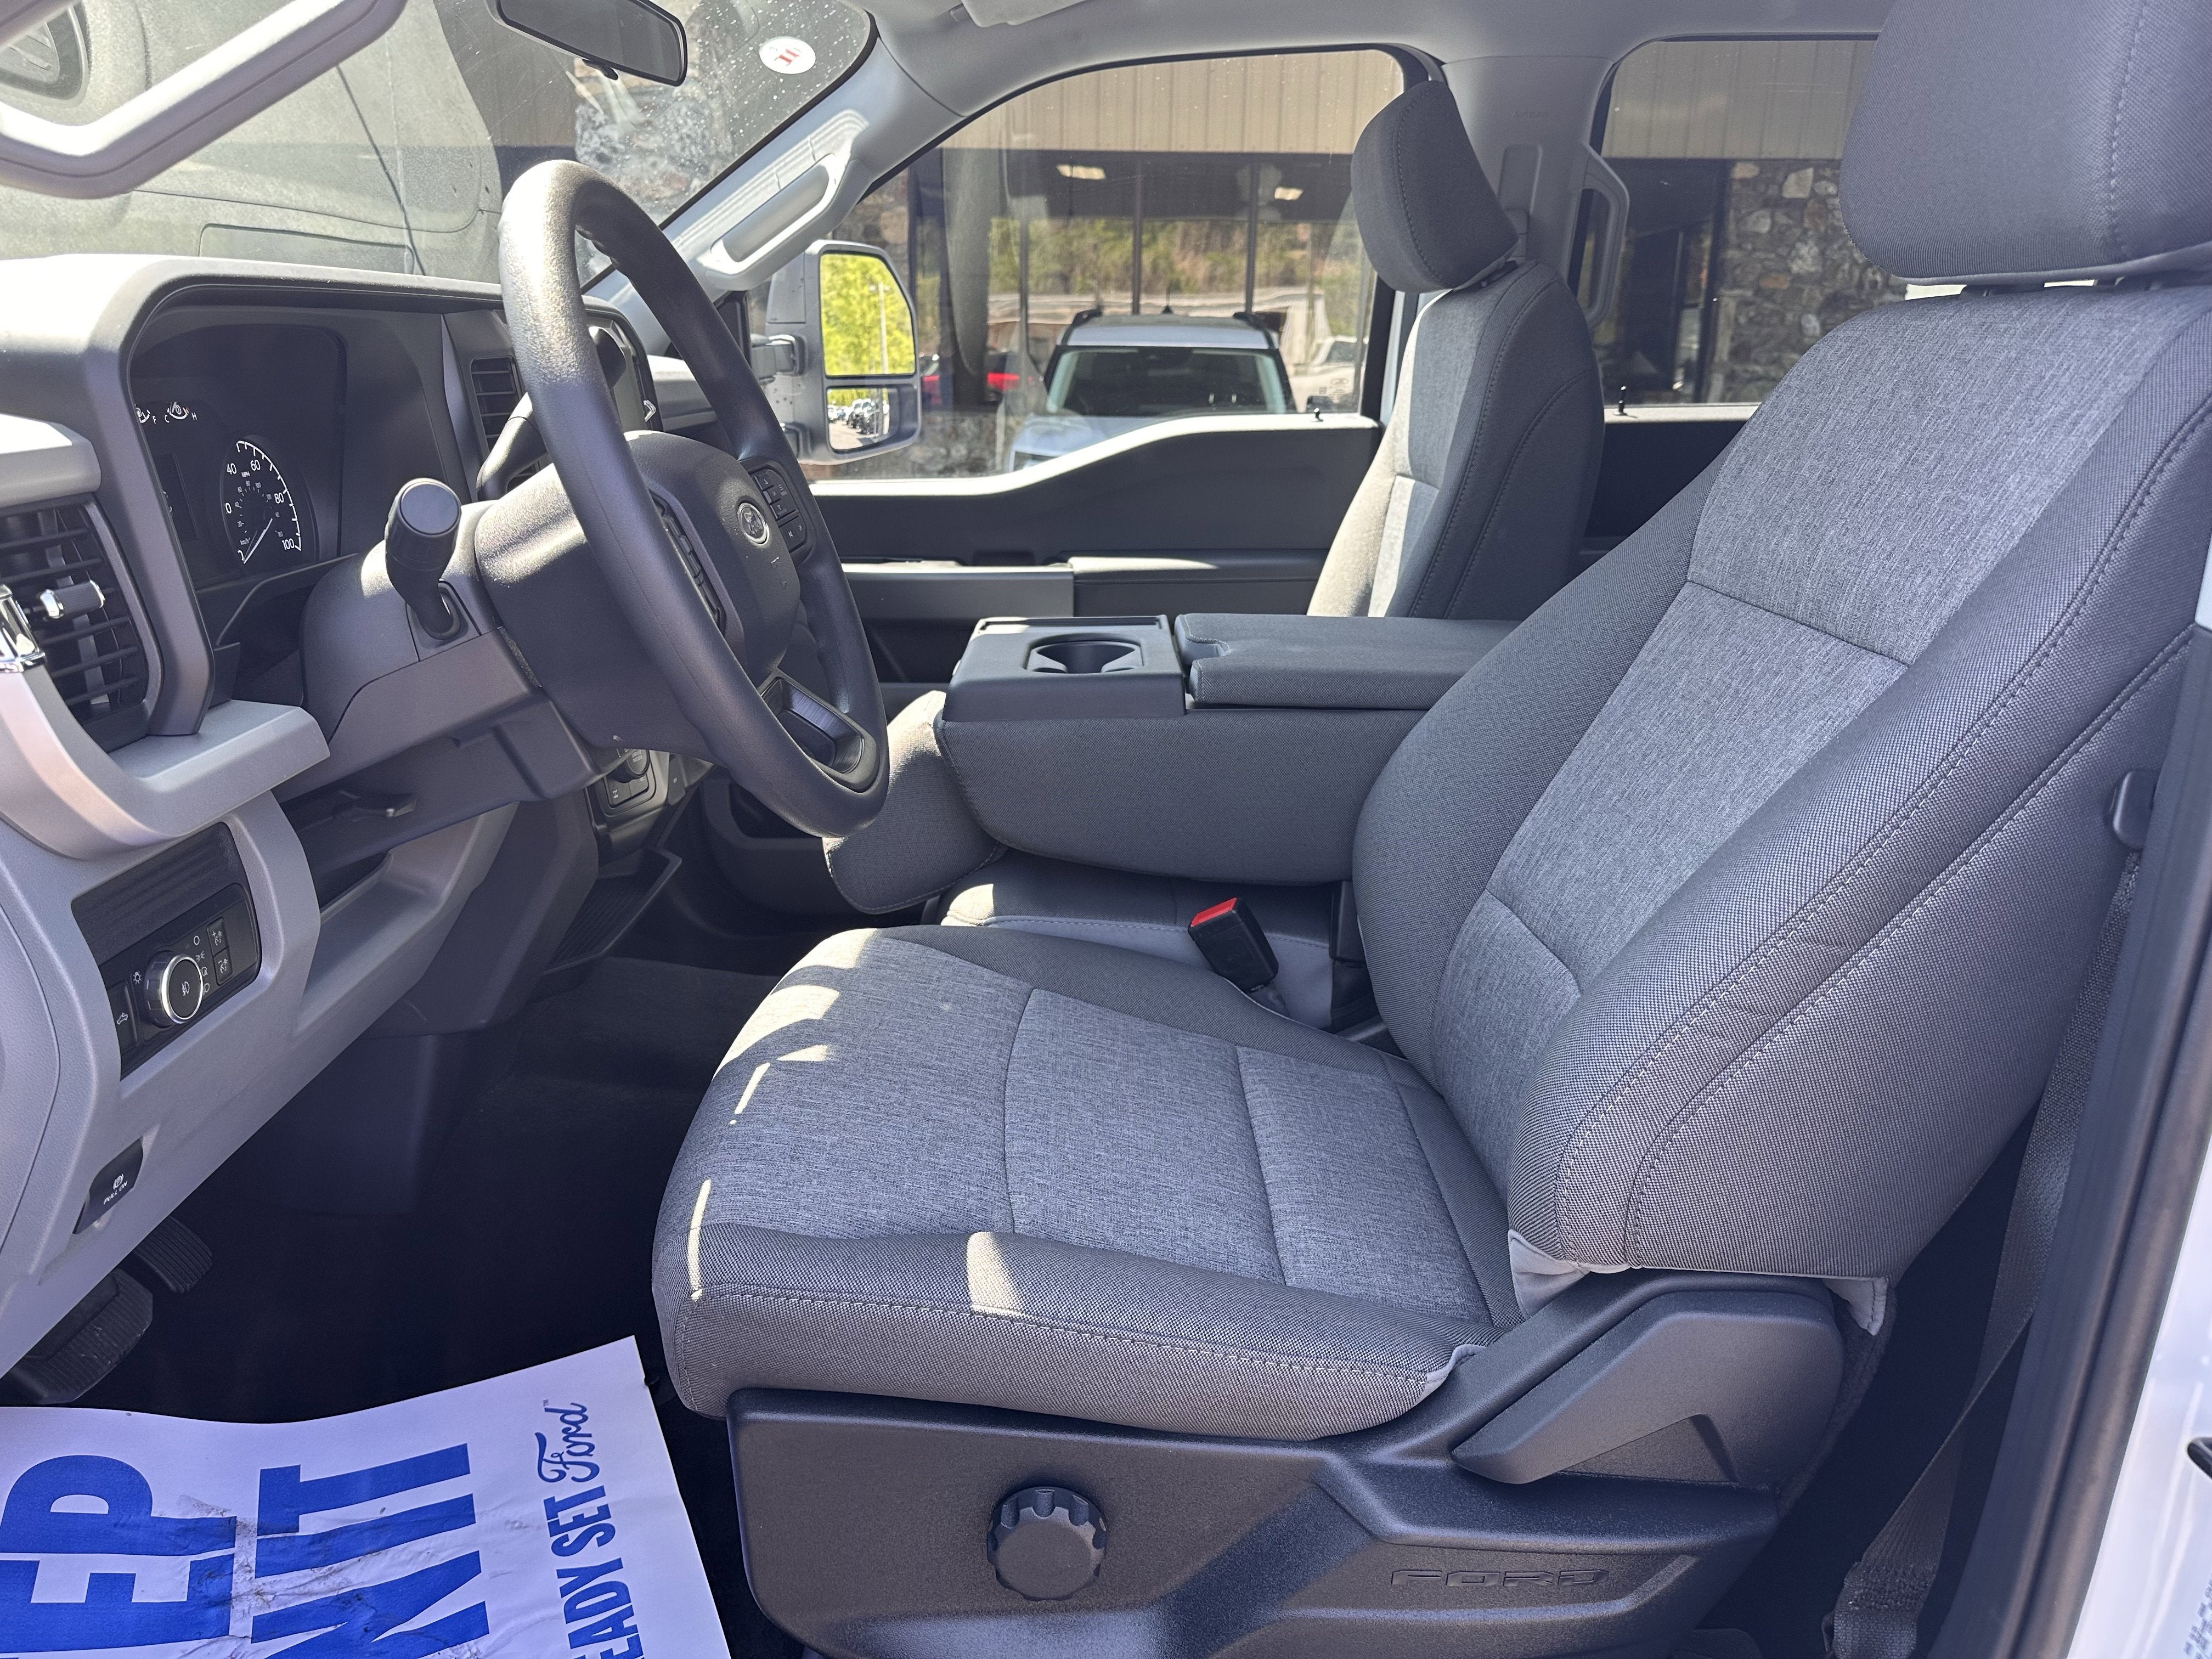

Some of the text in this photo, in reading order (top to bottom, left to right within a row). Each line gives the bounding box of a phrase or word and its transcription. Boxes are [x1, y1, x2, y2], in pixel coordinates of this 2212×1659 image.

[191, 412, 198, 420] H
[227, 462, 237, 475] 40
[250, 459, 261, 471] 60
[274, 492, 284, 504] 80
[225, 503, 232, 514] 0
[281, 538, 295, 550] 100
[534, 1402, 600, 1483] Ford
[543, 1485, 616, 1558] SET
[0, 1455, 236, 1659] EP
[1391, 1569, 1610, 1587] FORD
[556, 1557, 645, 1659] EADY
